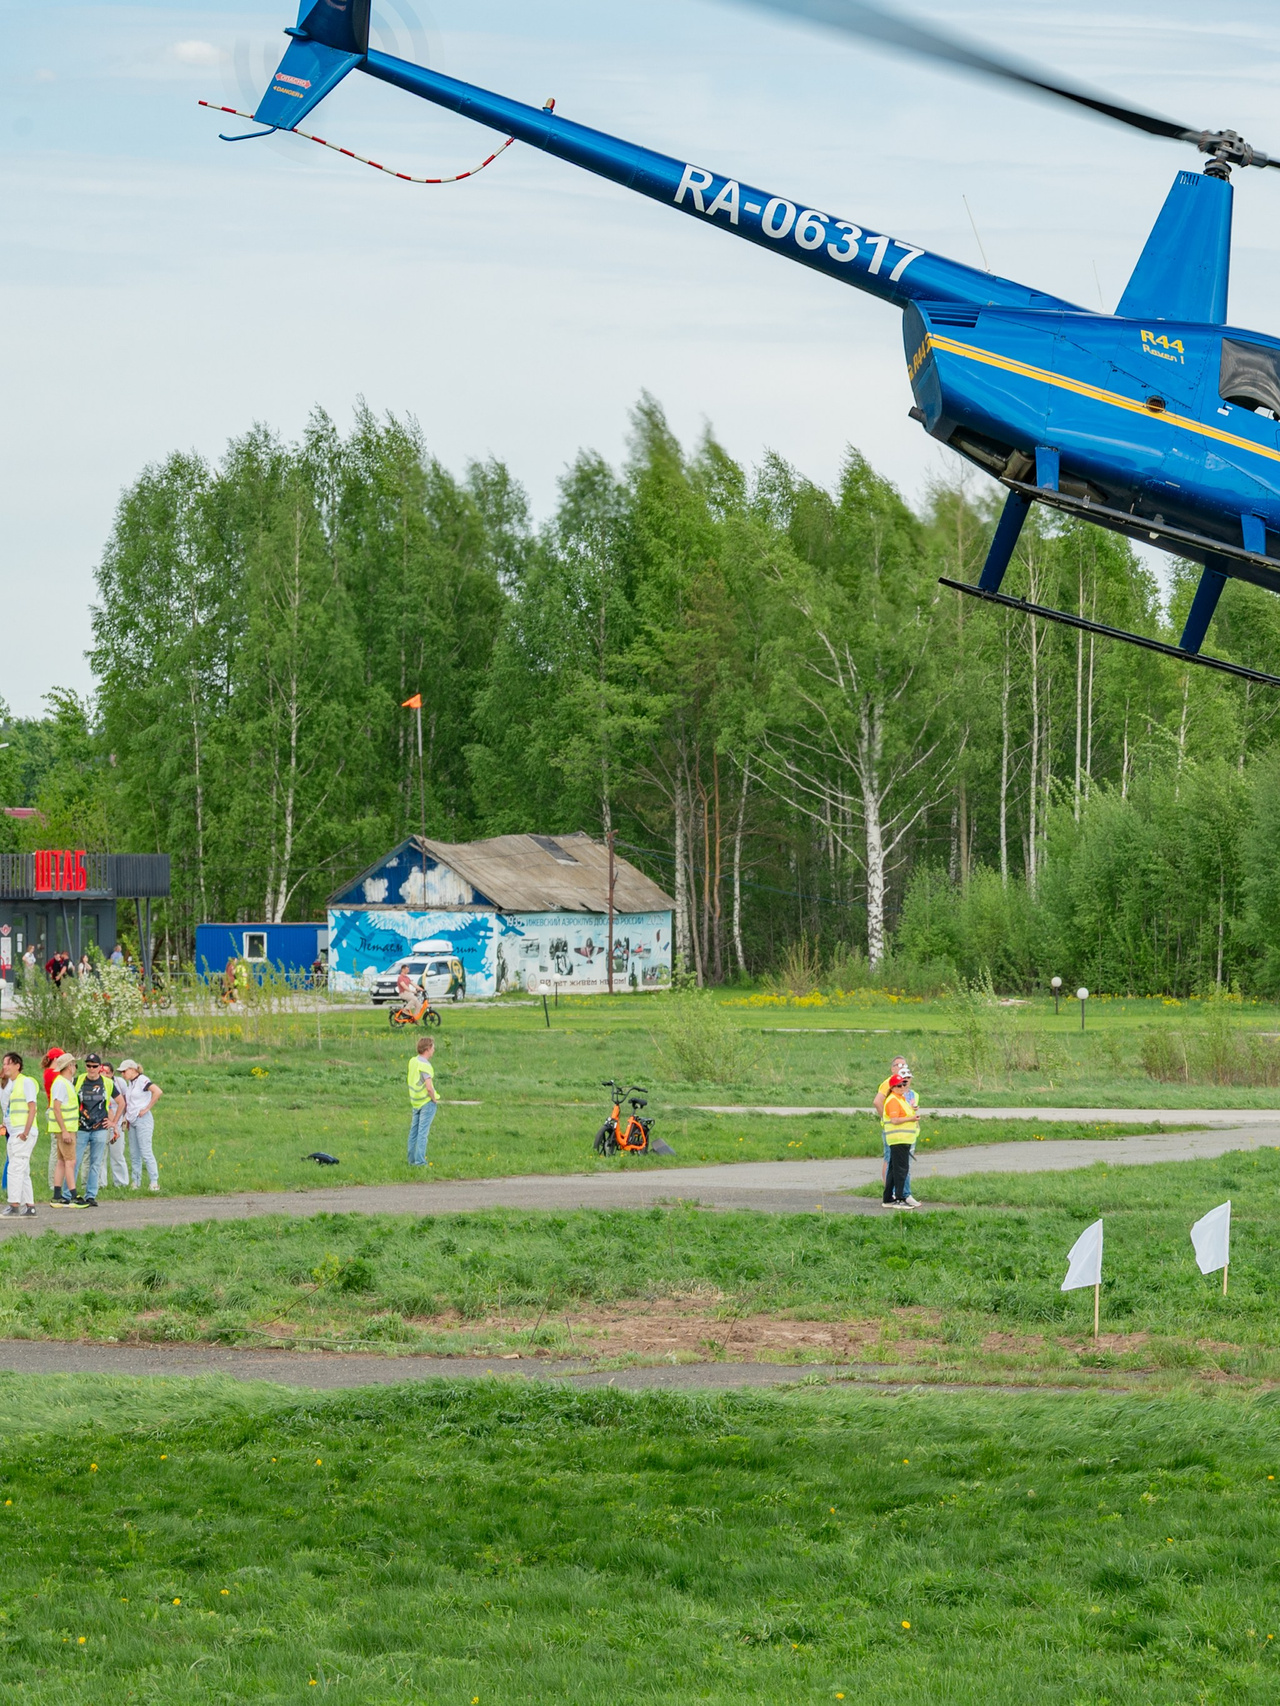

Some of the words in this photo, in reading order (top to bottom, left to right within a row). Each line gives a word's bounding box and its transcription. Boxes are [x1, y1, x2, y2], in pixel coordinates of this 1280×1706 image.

[673, 163, 925, 283] RA-06317
[1140, 329, 1185, 354] R44
[1142, 343, 1178, 363] Raven
[35, 850, 87, 892] ШТАБ
[355, 937, 404, 953] Летаем
